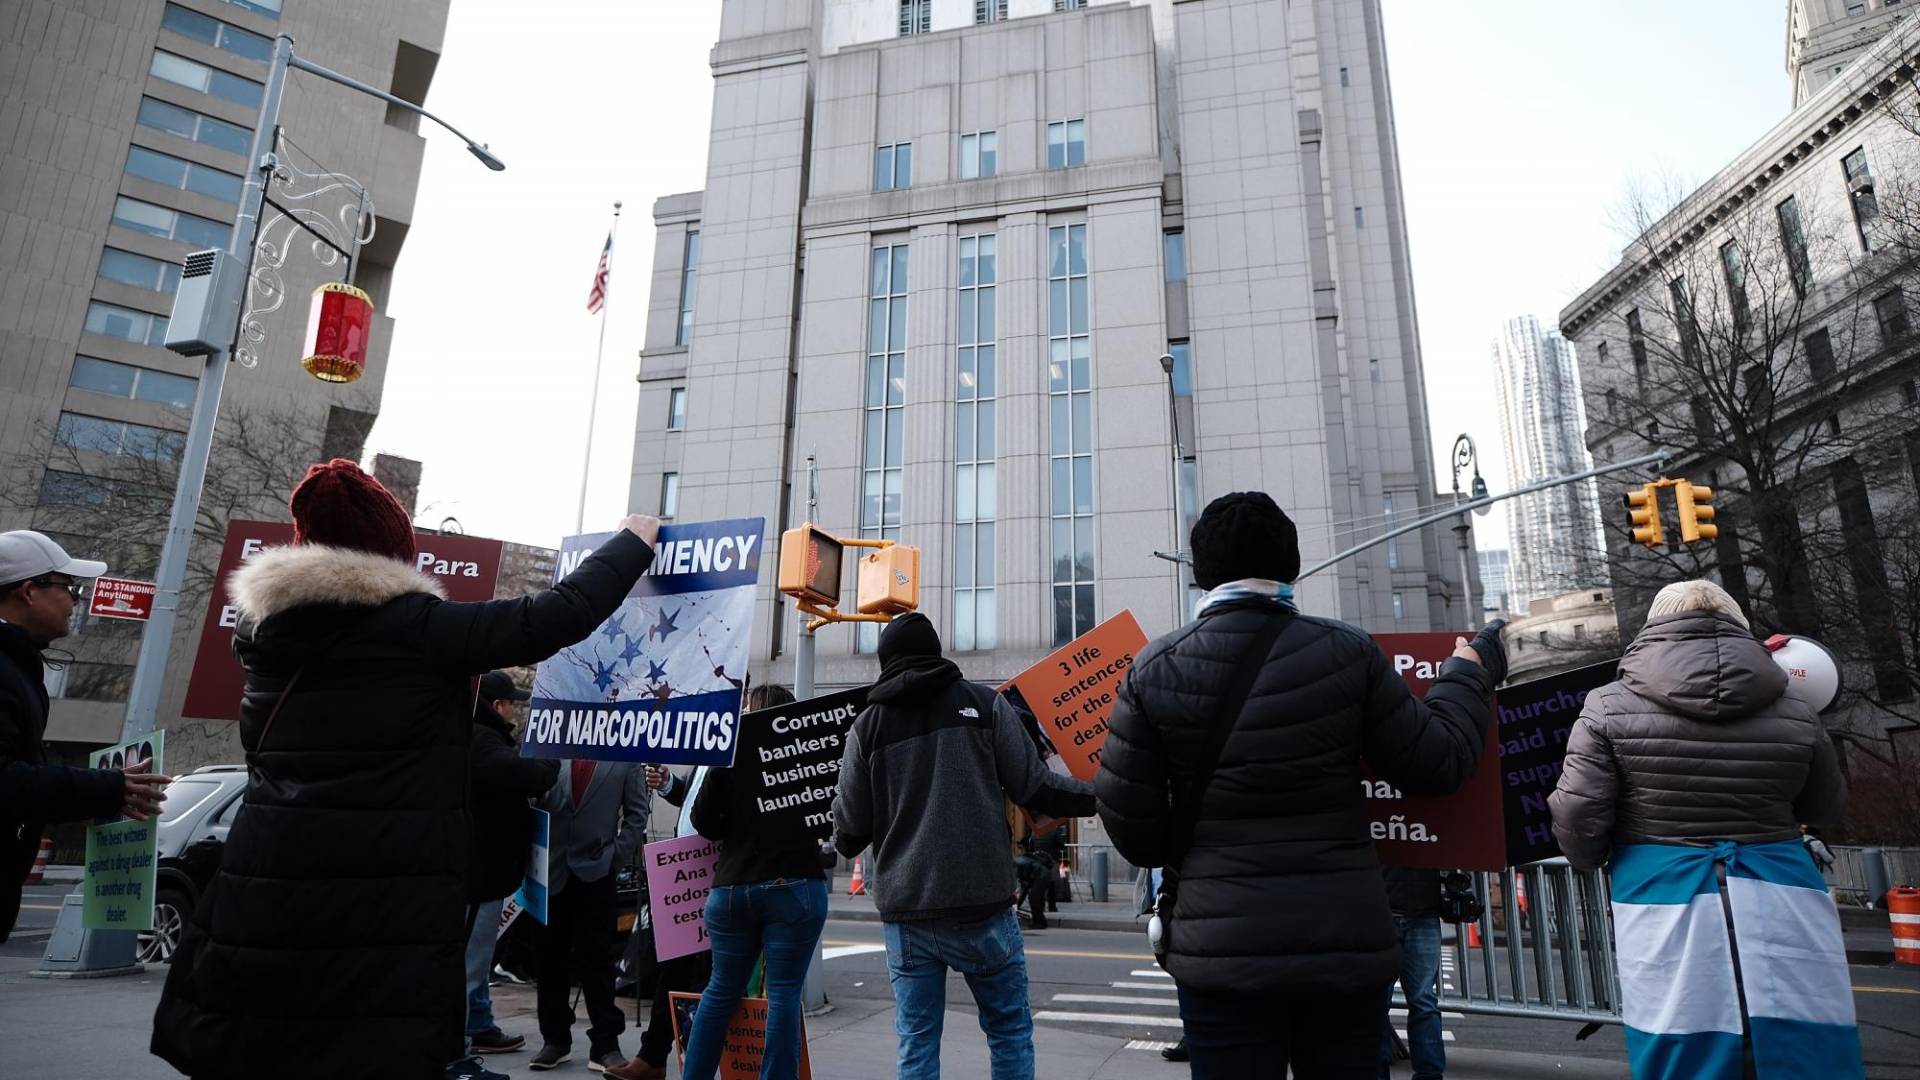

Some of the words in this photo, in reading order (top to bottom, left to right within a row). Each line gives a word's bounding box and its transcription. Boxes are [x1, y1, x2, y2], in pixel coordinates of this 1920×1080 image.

[416, 552, 480, 577] Para
[641, 534, 758, 576] MENCY
[98, 589, 135, 601] Anytime
[100, 581, 112, 590] NO
[114, 582, 156, 595] STANDING
[1059, 661, 1072, 677] 3
[1073, 646, 1102, 669] life
[1052, 653, 1134, 708] sentences
[771, 702, 857, 734] Corrupt
[1054, 709, 1079, 732] for
[1082, 692, 1113, 715] the
[525, 708, 564, 744] FOR
[565, 709, 734, 751] NARCOPOLITICS
[1073, 716, 1110, 746] deal
[758, 733, 840, 763] bankers
[96, 831, 108, 848] The
[674, 867, 708, 884] Ana
[664, 888, 709, 906] todos
[741, 1007, 749, 1020] 3
